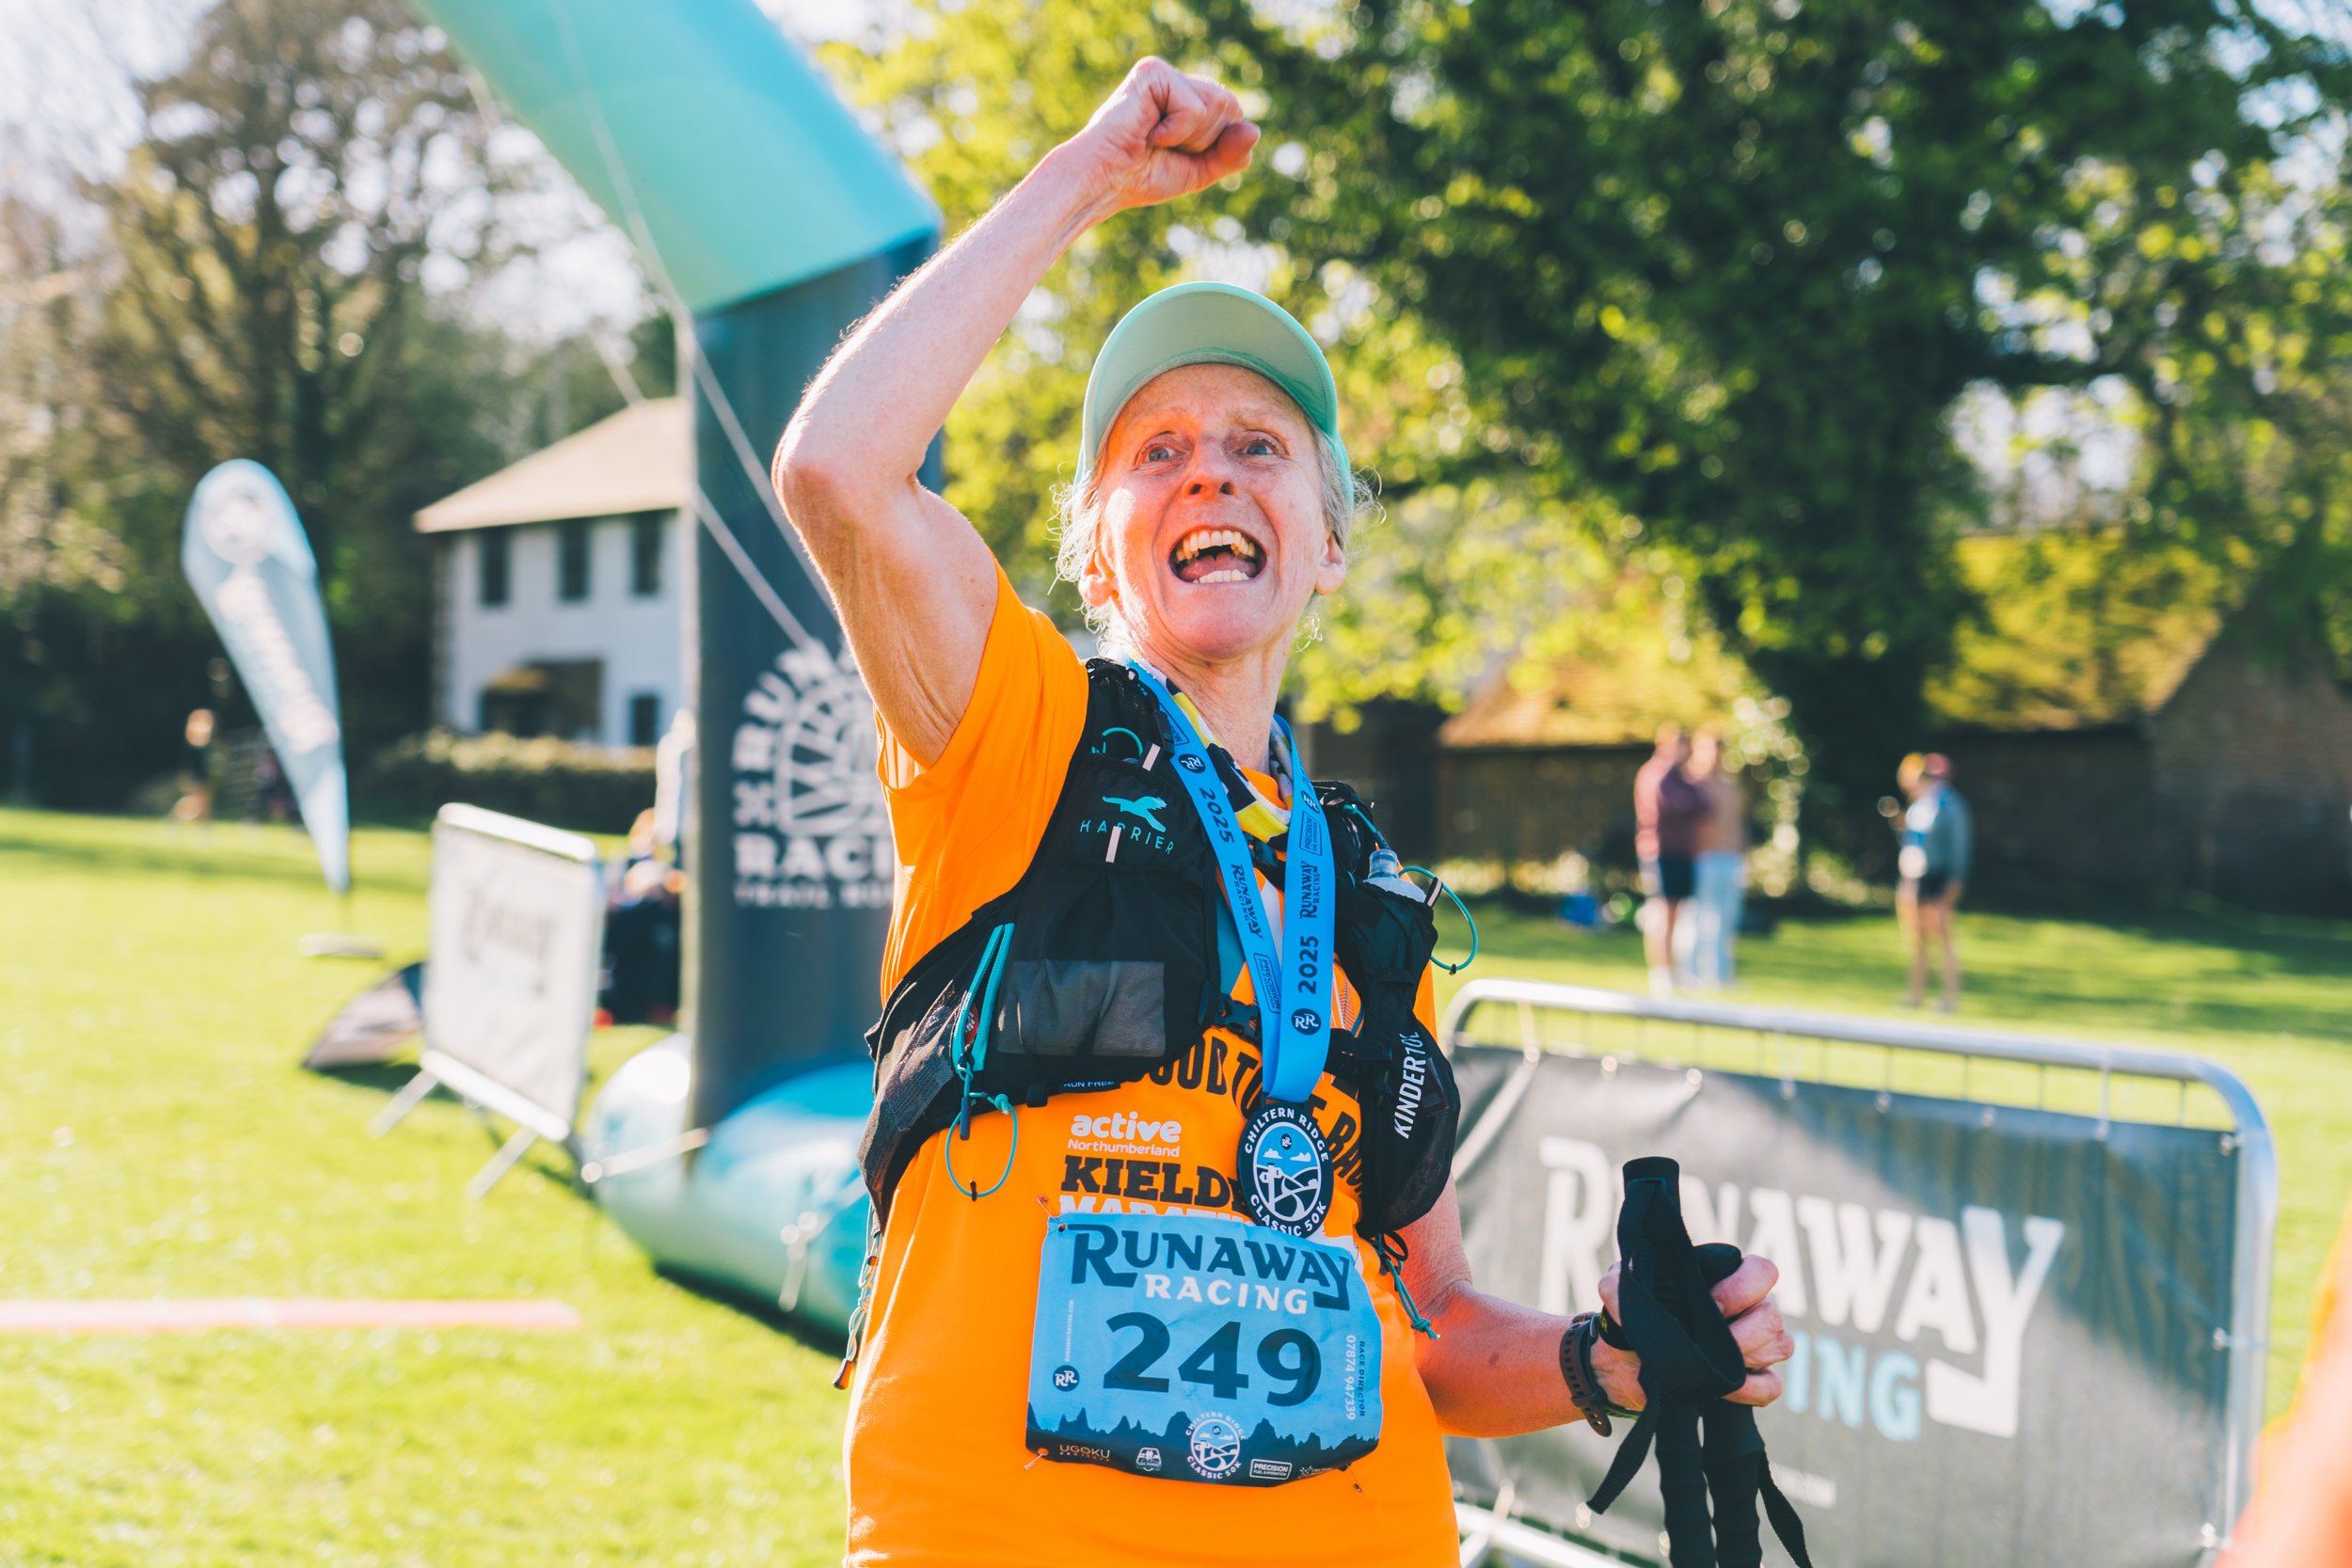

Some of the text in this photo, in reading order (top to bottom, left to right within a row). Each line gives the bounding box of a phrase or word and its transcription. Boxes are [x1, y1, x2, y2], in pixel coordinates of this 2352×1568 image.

[1079, 819, 1174, 855] HARIER
[1199, 787, 1235, 844] 2025
[733, 832, 894, 881] RACI
[1230, 863, 1263, 940] RUNAWAY
[1233, 879, 1251, 923] RACING
[1299, 860, 1318, 919] RUNAWAY
[1312, 872, 1321, 903] RACING
[1262, 958, 1281, 1010] PRECISION
[1297, 936, 1319, 994] 2025
[1295, 1014, 1319, 1029] RR
[1067, 1139, 1181, 1158] Northumberland
[1071, 1111, 1183, 1143] active
[1244, 1107, 1329, 1162] CHILTERN RIDGE
[1060, 1154, 1248, 1212] KIELD
[1250, 1194, 1301, 1237] CLASSIC
[1304, 1200, 1327, 1232] 50K
[1067, 1223, 1351, 1312] RUNAWAY
[1537, 1136, 2065, 1437] RNAWAY
[1144, 1273, 1309, 1315] RACING
[1055, 1370, 1078, 1387] RR
[1102, 1311, 1323, 1408] 249
[1344, 1335, 1357, 1420] 07874 947339
[1358, 1369, 1366, 1418] DIRECTOR
[1786, 1330, 1922, 1442] ING
[1058, 1444, 1111, 1459] UGOKU
[1186, 1455, 1243, 1481] CLASSIC 50K
[1253, 1463, 1289, 1473] PRECISION
